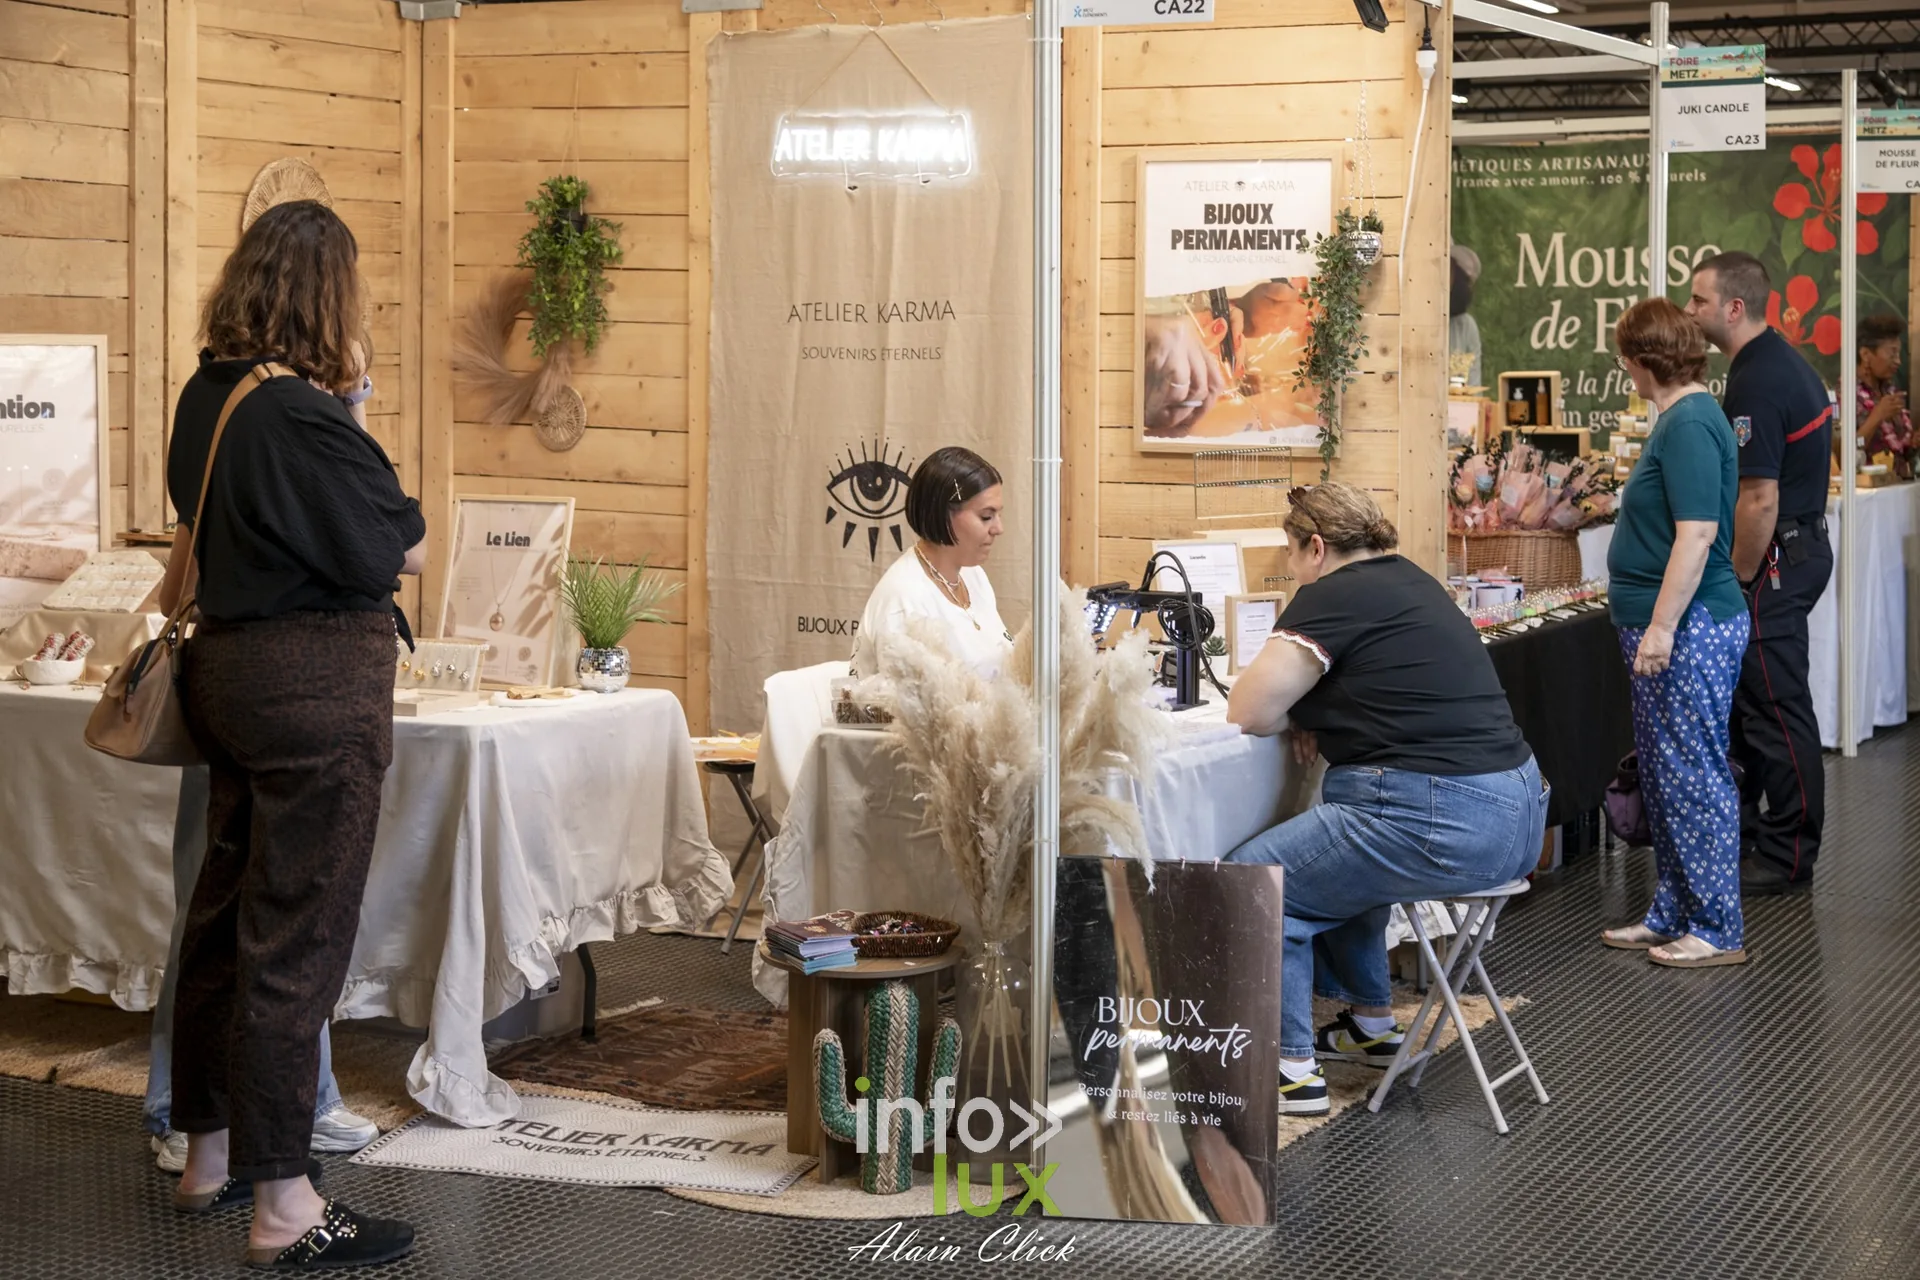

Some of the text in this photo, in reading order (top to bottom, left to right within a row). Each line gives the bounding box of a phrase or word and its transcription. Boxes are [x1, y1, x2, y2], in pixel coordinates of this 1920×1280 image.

[1154, 0, 1206, 15] CA22
[1670, 69, 1699, 79] METZ
[1678, 103, 1750, 115] JUKI CANDLE
[1863, 126, 1887, 134] METZ
[774, 127, 968, 163] ATELIER KARMA
[1725, 135, 1760, 145] CA23
[1879, 149, 1917, 157] MOUSSE
[1875, 160, 1887, 168] DE
[1184, 180, 1295, 192] ATELIER KARMA
[1456, 176, 1500, 187] France
[1504, 176, 1535, 187] avec
[1628, 171, 1641, 182] %
[1204, 203, 1273, 225] BIJOUX
[1171, 229, 1306, 250] PERMANENTS
[787, 300, 956, 323] ATELIER KARMA
[1531, 300, 1581, 350] de
[801, 346, 877, 361] SOUVENIRS
[1577, 370, 1597, 395] la
[486, 531, 531, 547] Le Lien
[797, 616, 848, 636] BIJOUX
[1098, 996, 1206, 1027] BIJOUX
[1083, 1023, 1252, 1067] permanents
[1078, 1082, 1242, 1108] Personnalisez votre bijou
[1121, 1110, 1160, 1122] restez
[1164, 1111, 1187, 1124] liés
[1191, 1112, 1198, 1125] à
[1203, 1113, 1222, 1126] vie
[476, 1118, 778, 1156] TELIER KARMA
[492, 1136, 602, 1157] SOUVENIRS
